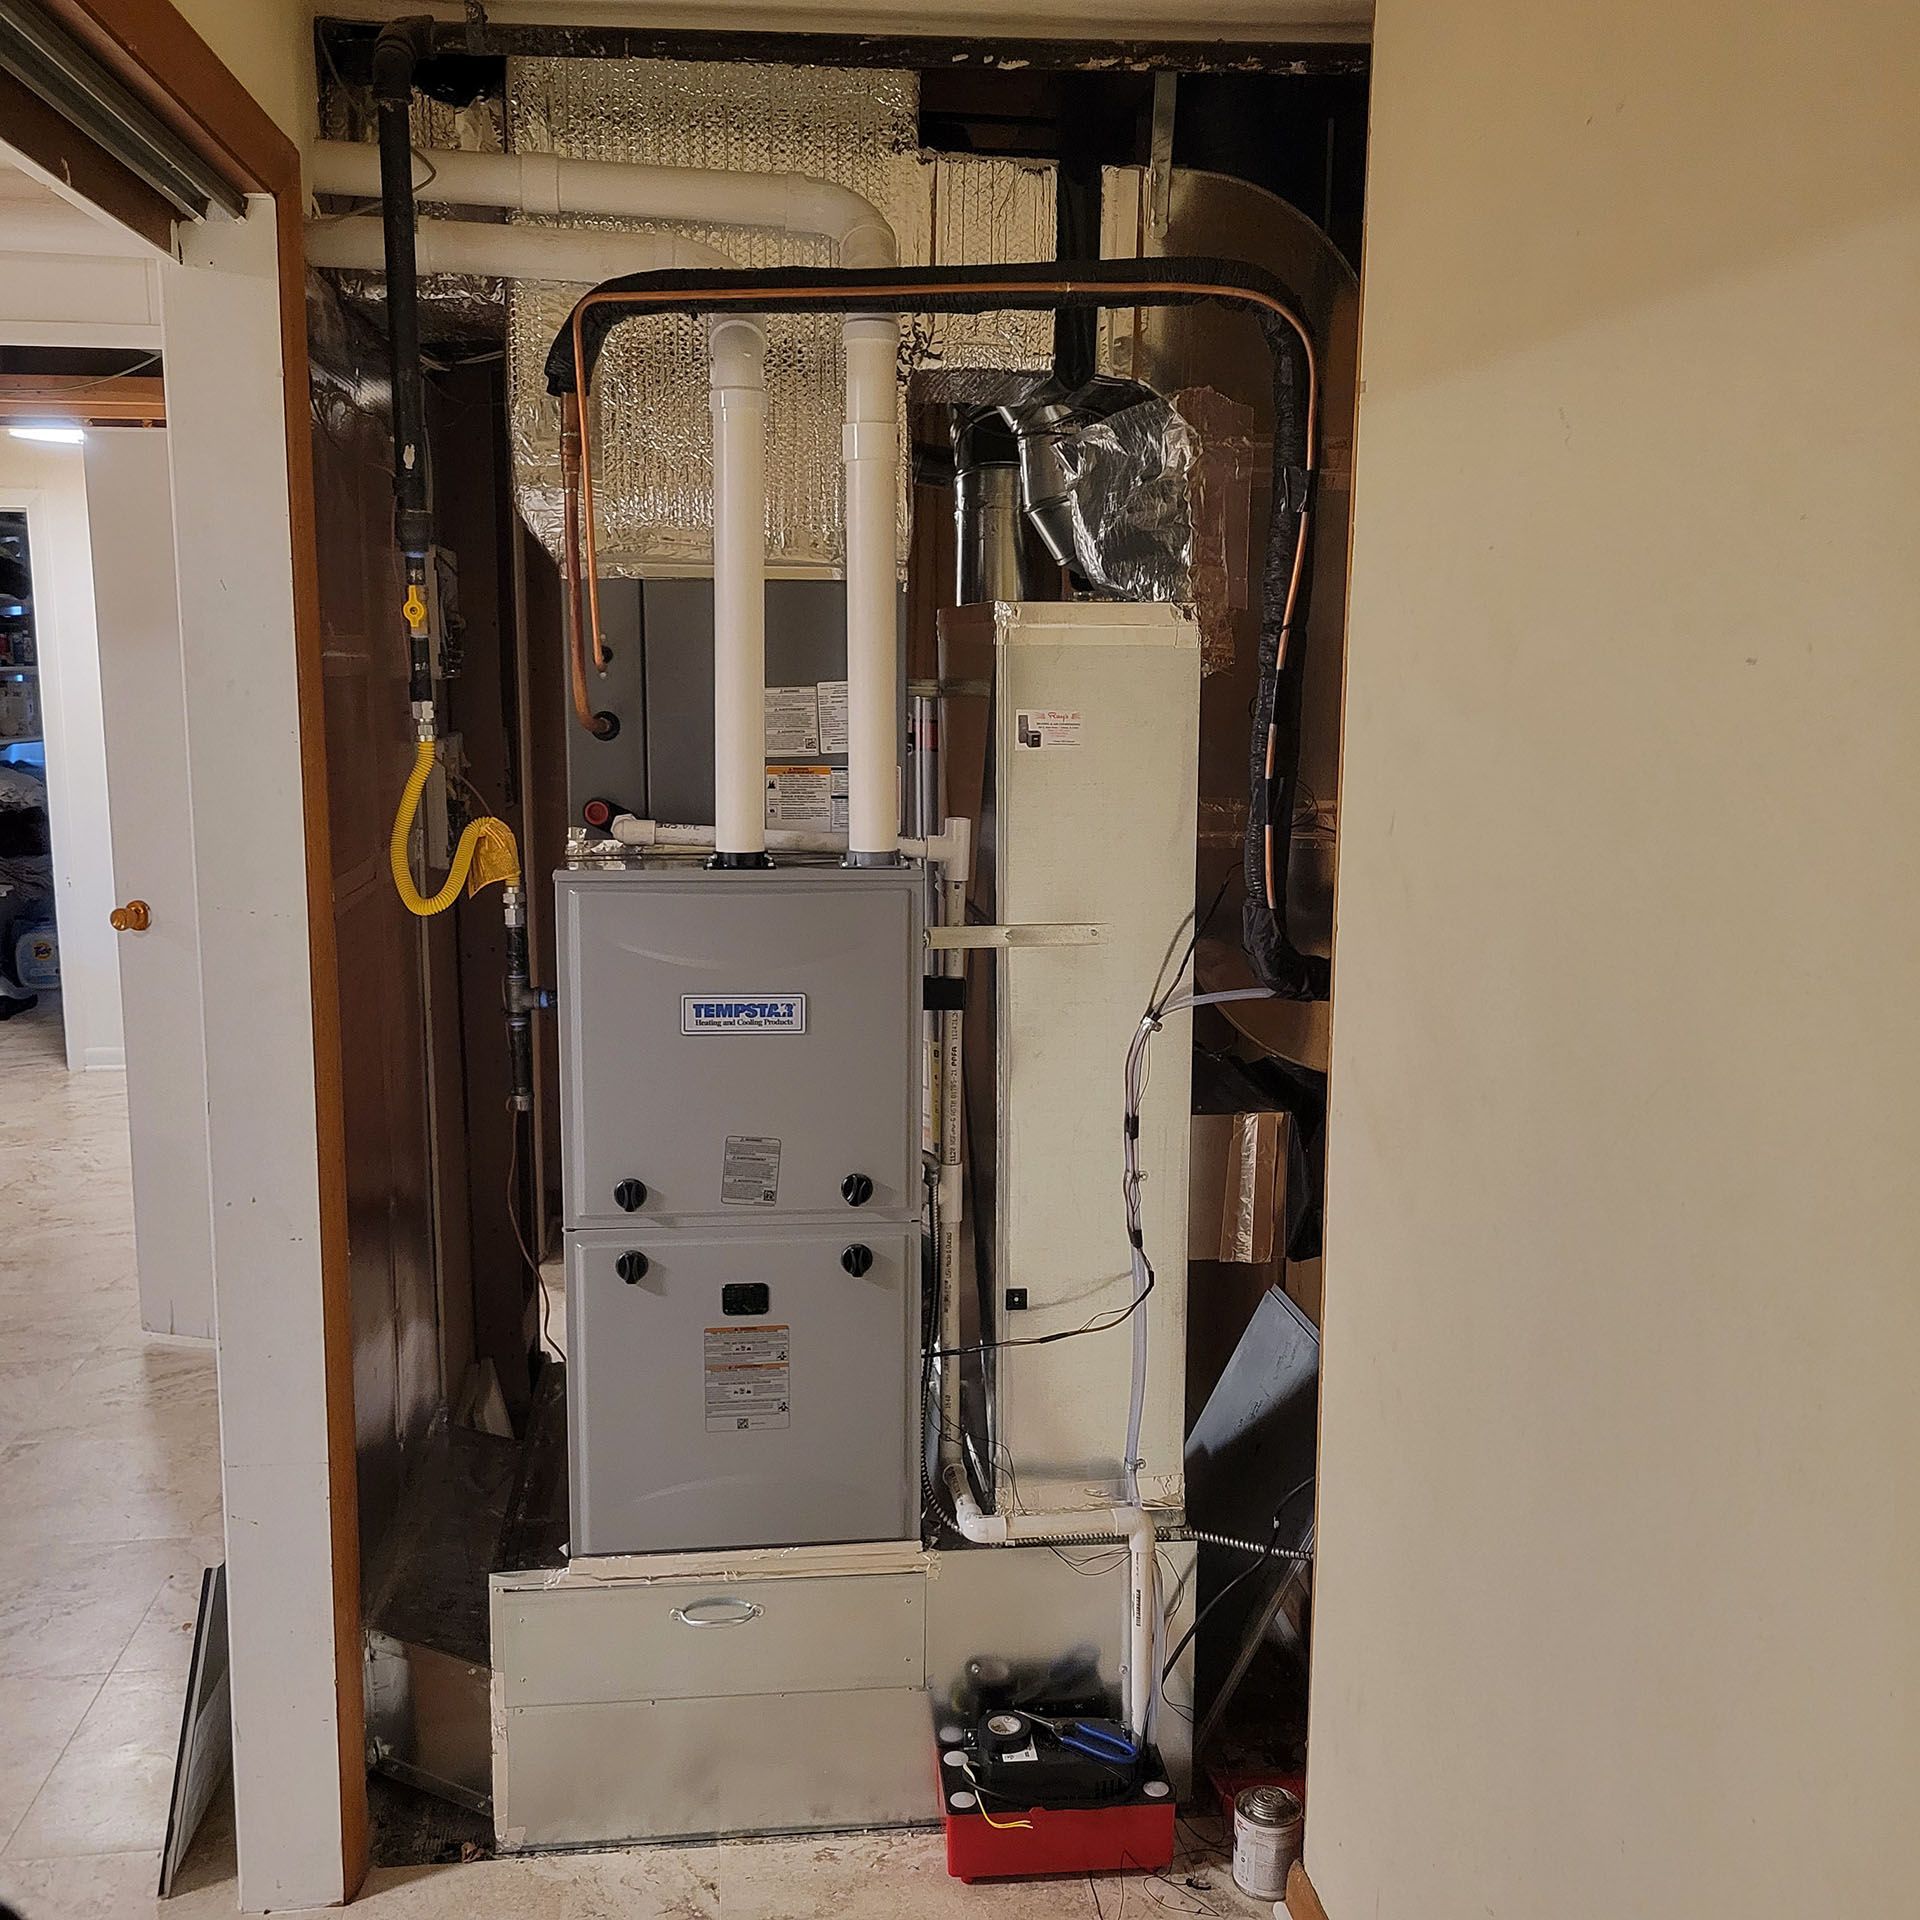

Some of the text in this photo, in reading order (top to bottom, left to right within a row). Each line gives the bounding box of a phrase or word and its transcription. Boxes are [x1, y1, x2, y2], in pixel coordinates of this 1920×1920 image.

[692, 1003, 794, 1018] TEMPSTAR
[695, 1018, 793, 1027] Heating and Cooling Products
